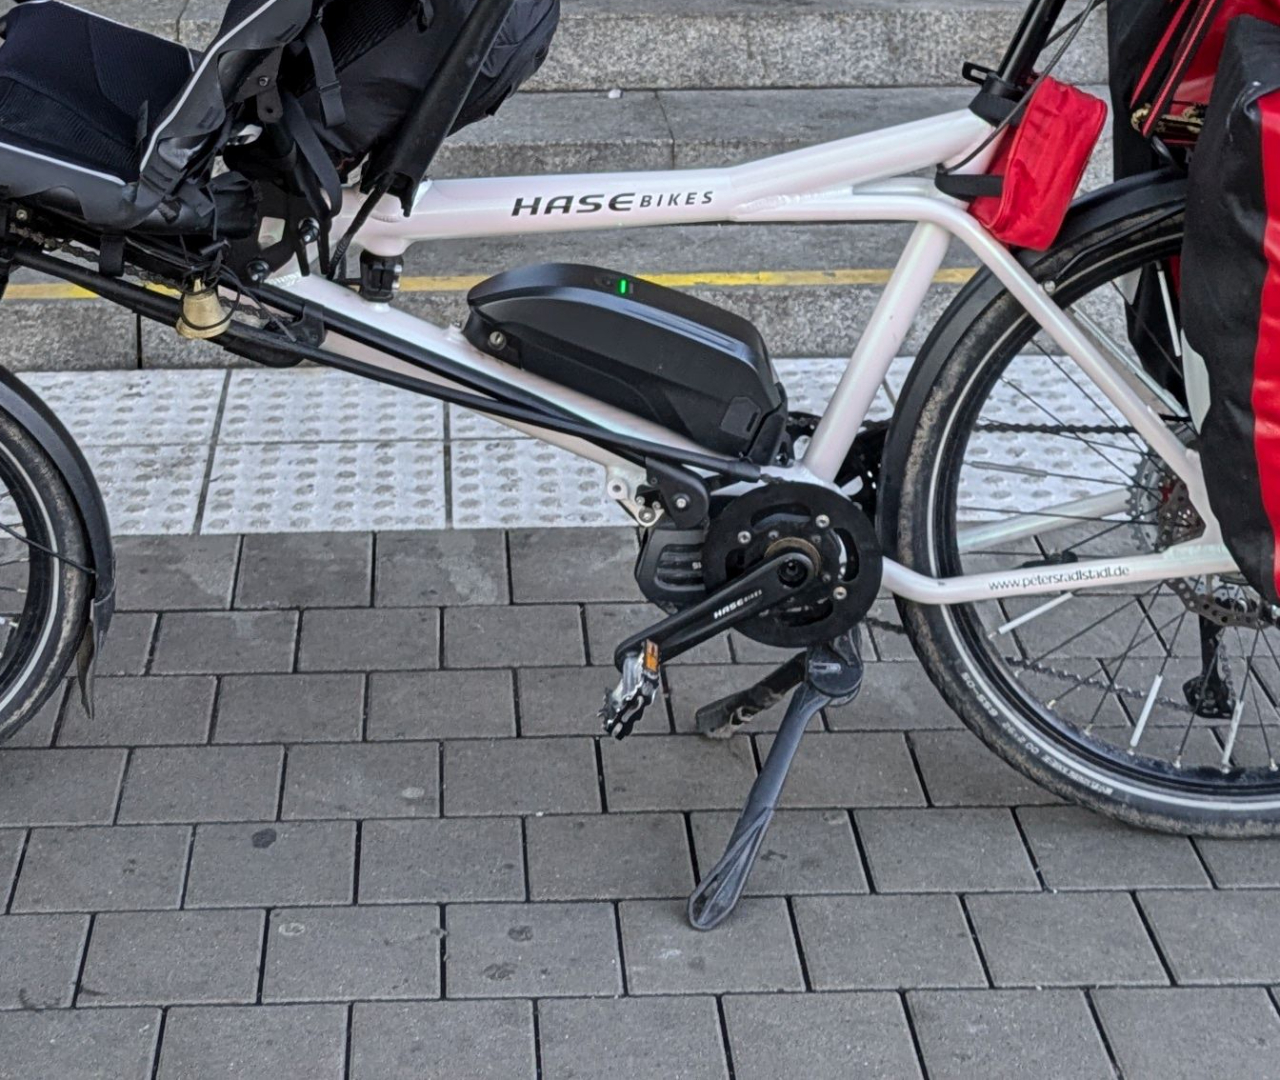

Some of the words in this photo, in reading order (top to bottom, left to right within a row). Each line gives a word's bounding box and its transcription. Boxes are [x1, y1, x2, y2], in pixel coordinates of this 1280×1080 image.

[511, 192, 636, 217] HASE
[639, 191, 713, 208] BIKES
[988, 565, 1130, 591] www.petersradlstadl.de
